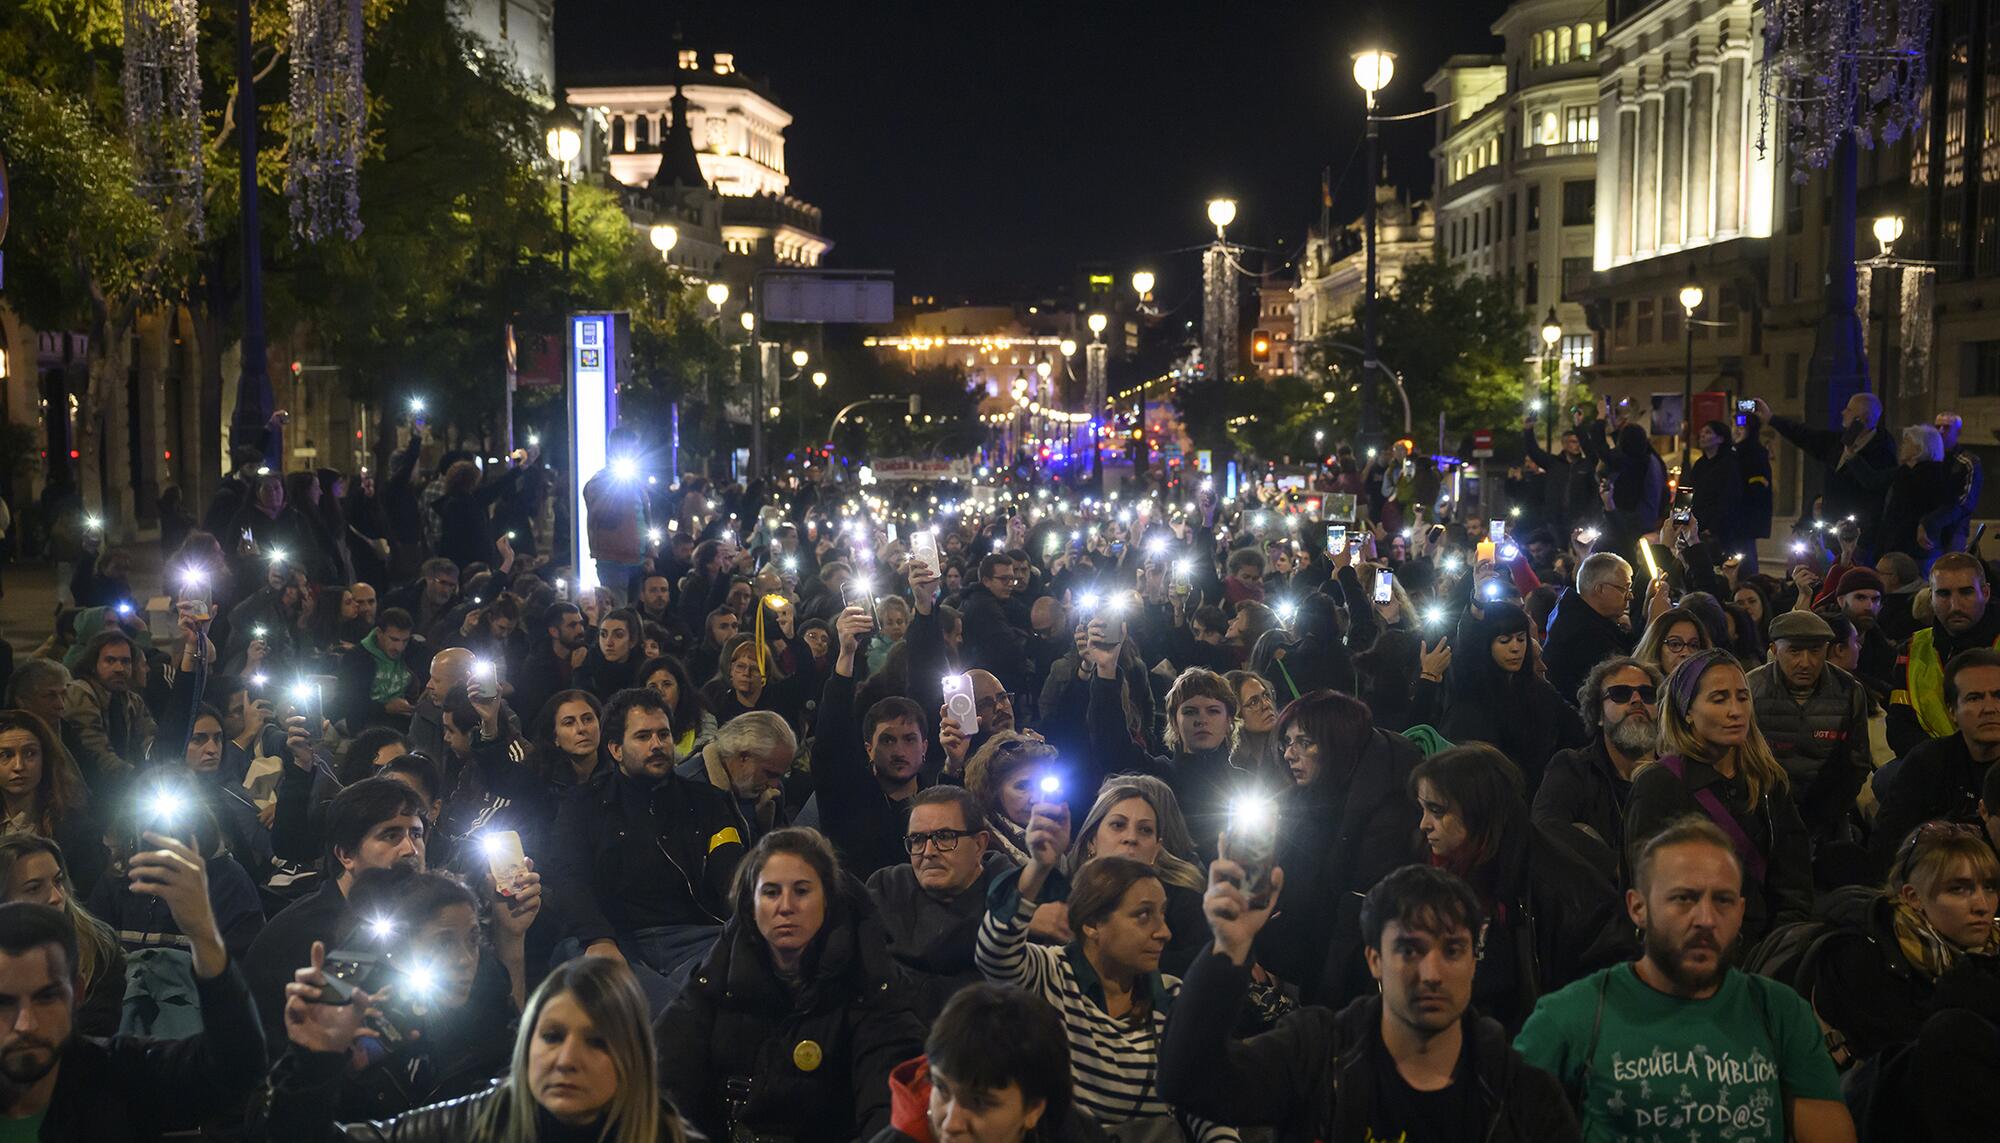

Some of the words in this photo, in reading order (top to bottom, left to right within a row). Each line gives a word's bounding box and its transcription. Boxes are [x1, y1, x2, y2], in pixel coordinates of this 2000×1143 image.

[1614, 1051, 1699, 1081] ESCUELA
[1635, 1106, 1668, 1127] DE
[1681, 1103, 1766, 1129] TOD@S
